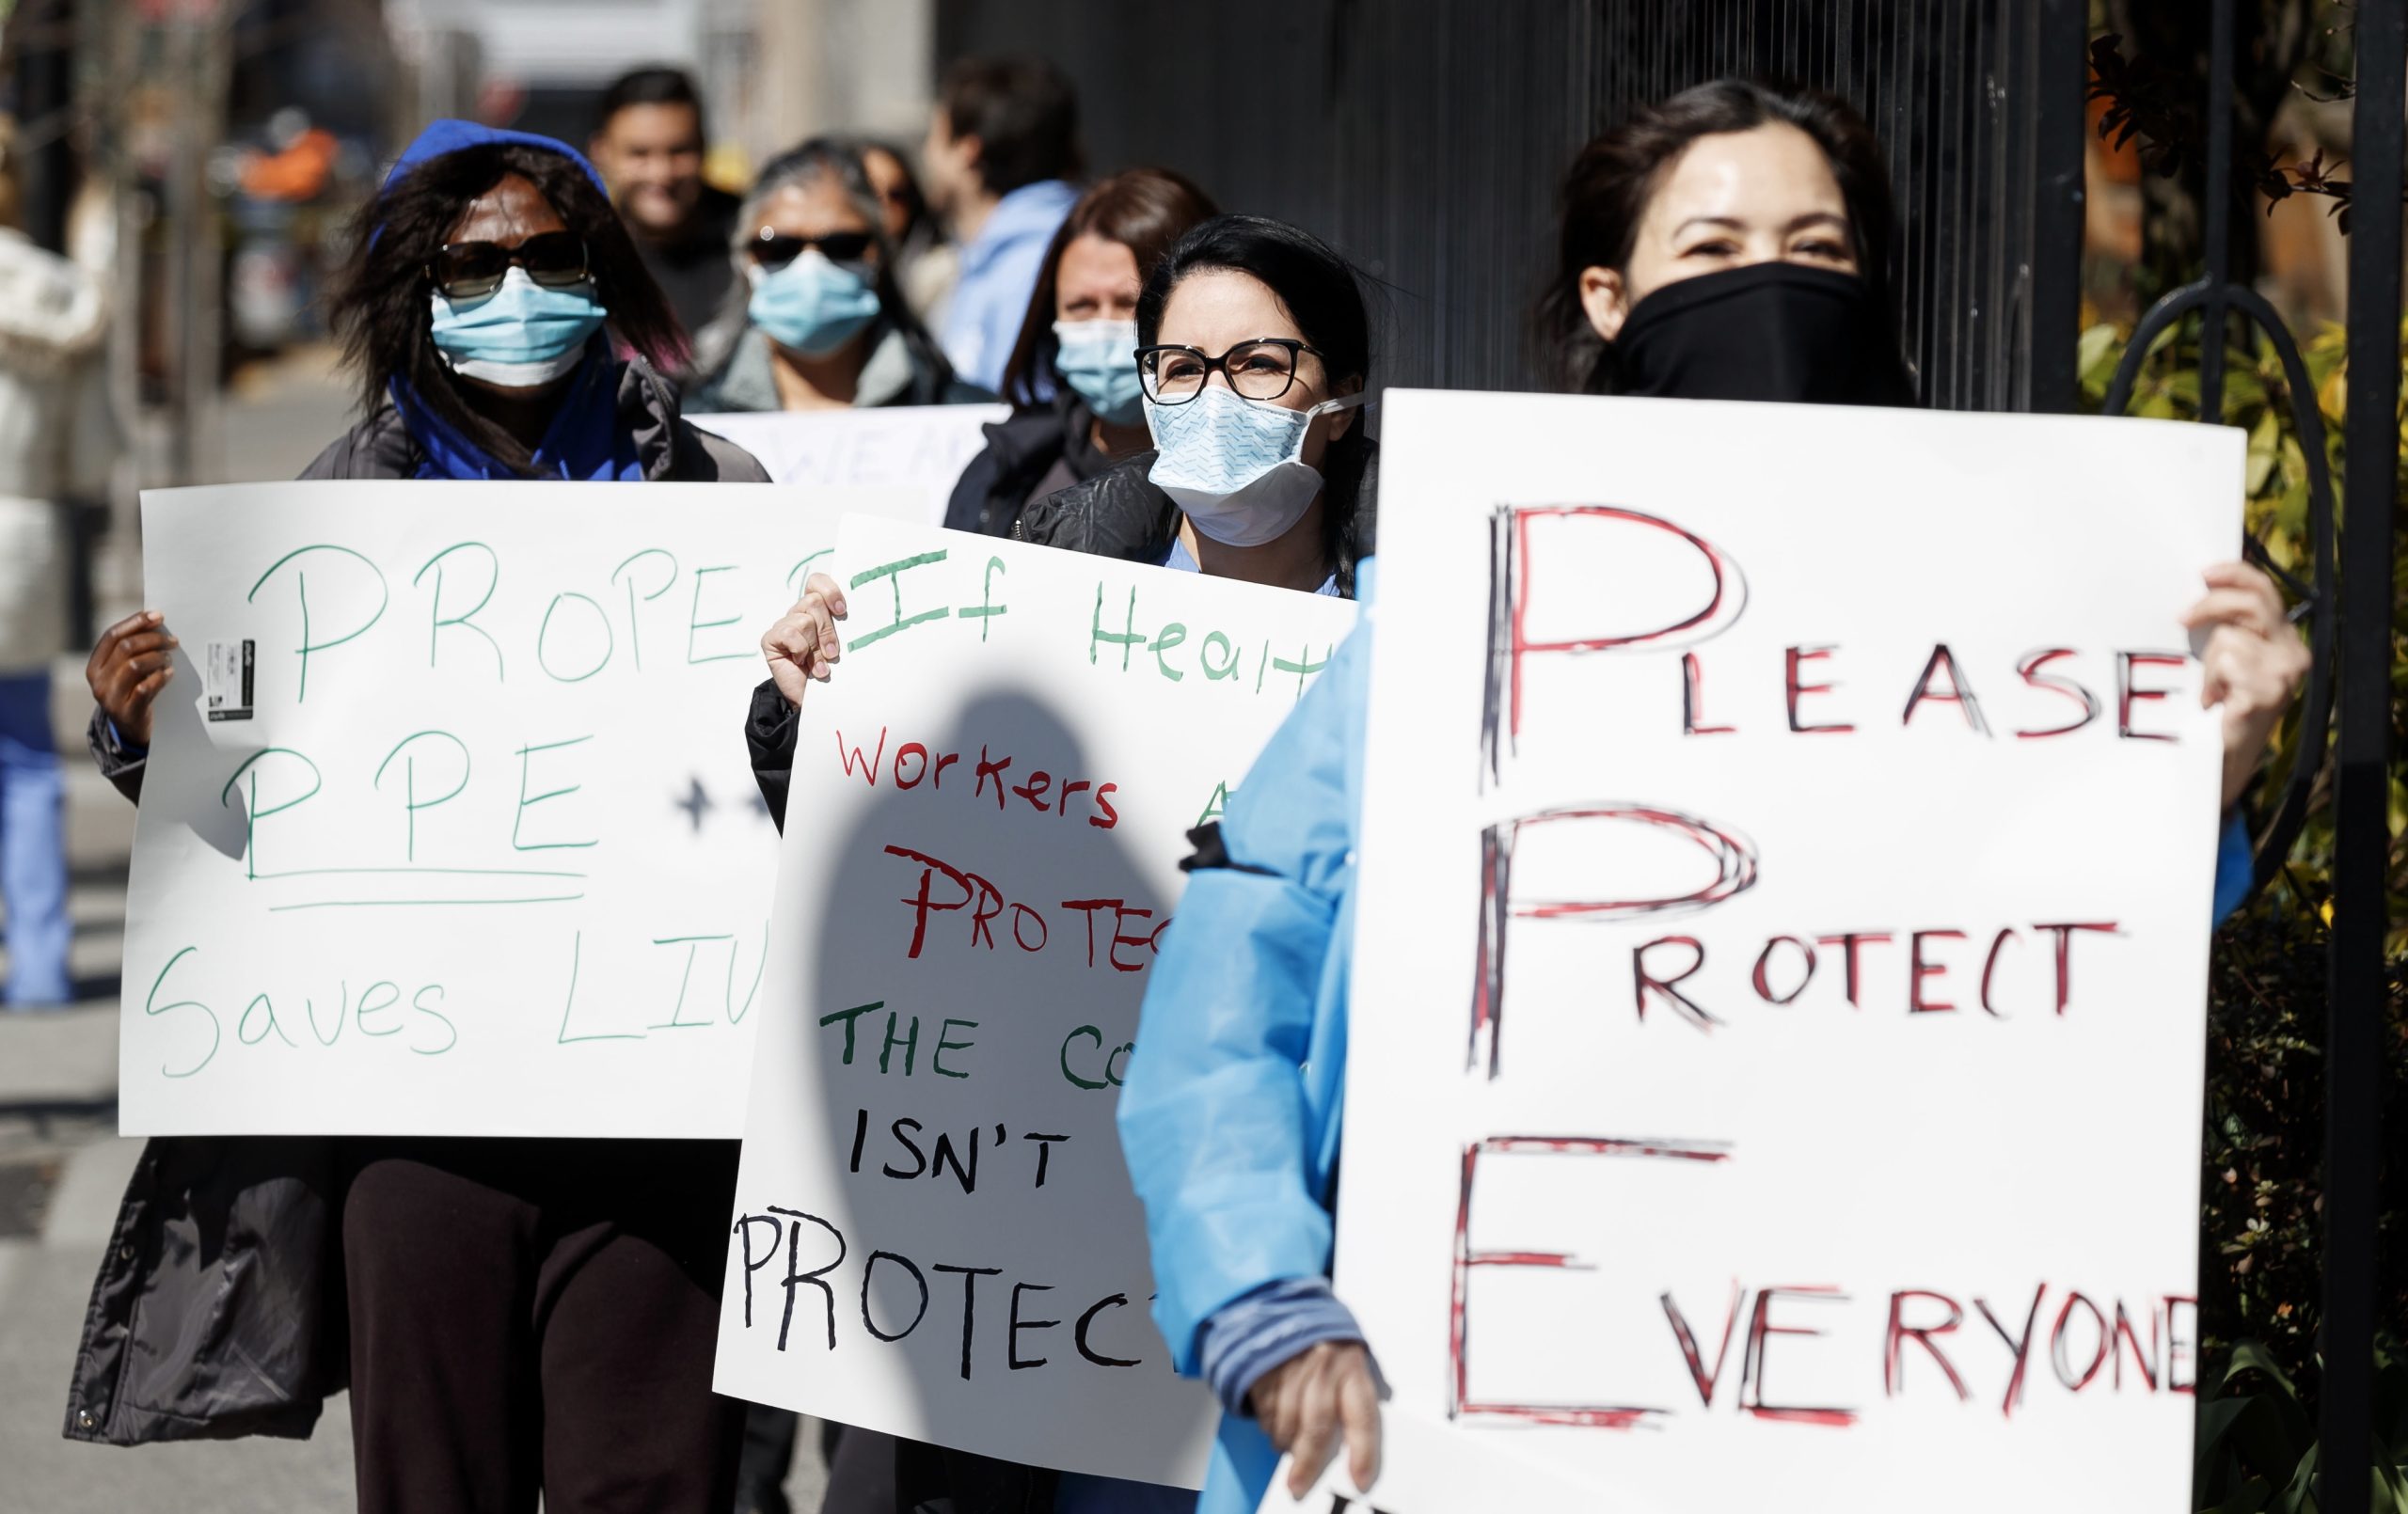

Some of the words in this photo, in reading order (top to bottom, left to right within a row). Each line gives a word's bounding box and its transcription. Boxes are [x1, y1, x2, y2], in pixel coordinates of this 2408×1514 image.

[247, 542, 835, 703] PROPE
[848, 547, 1008, 654] If
[1088, 579, 1333, 703] Healt
[1478, 502, 2190, 797] PLEASE
[222, 730, 599, 881] PPE
[835, 725, 1118, 830] Workers
[146, 945, 457, 1078] Saves
[1465, 799, 2131, 1082] PROTECT
[818, 1001, 980, 1079] THE
[849, 1108, 1071, 1195] ISN'T
[733, 1205, 1182, 1381] PROTEC
[1447, 1134, 2198, 1430] EVERYONE
